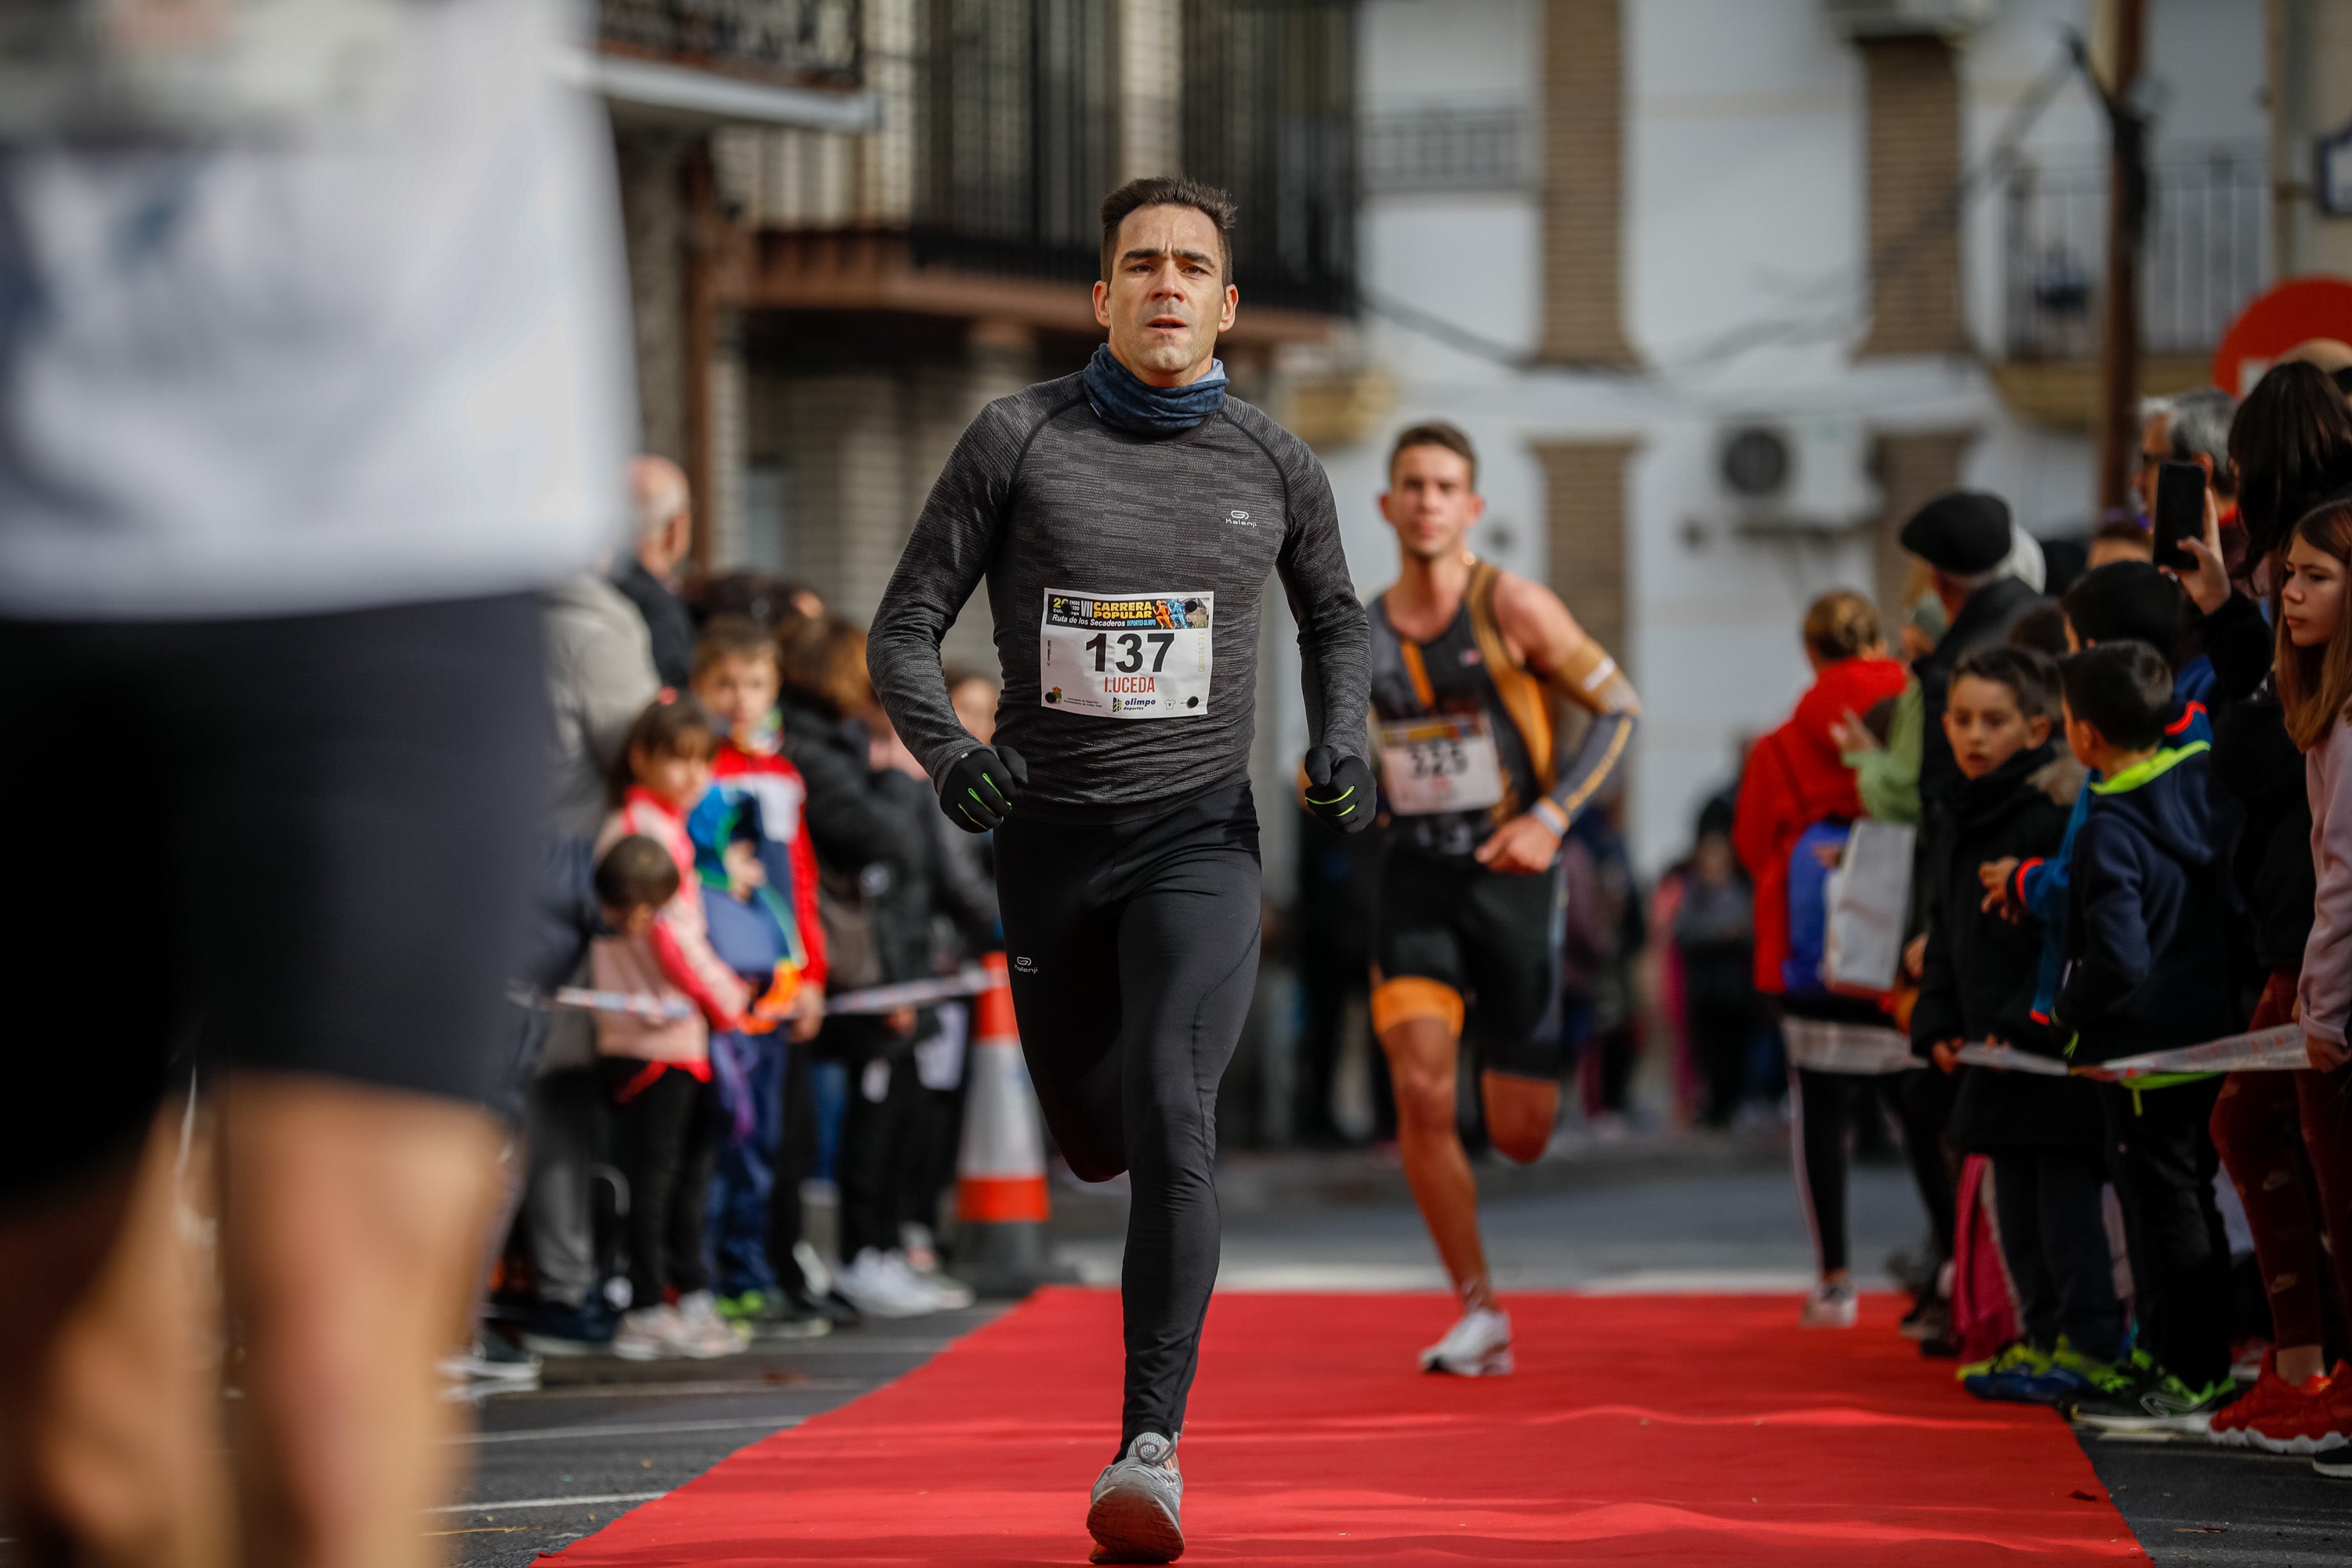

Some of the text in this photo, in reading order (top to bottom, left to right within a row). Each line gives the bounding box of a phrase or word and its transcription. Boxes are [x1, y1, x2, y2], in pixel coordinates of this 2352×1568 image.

[1081, 600, 1093, 618] VII
[1094, 601, 1152, 611] CARRERA
[1094, 611, 1152, 619] POPULAR
[1079, 617, 1088, 626] los
[1090, 619, 1126, 627] Secaderos
[1086, 633, 1174, 673] 137
[1104, 677, 1156, 693] I.UCEDA
[1124, 698, 1156, 707] olimpo
